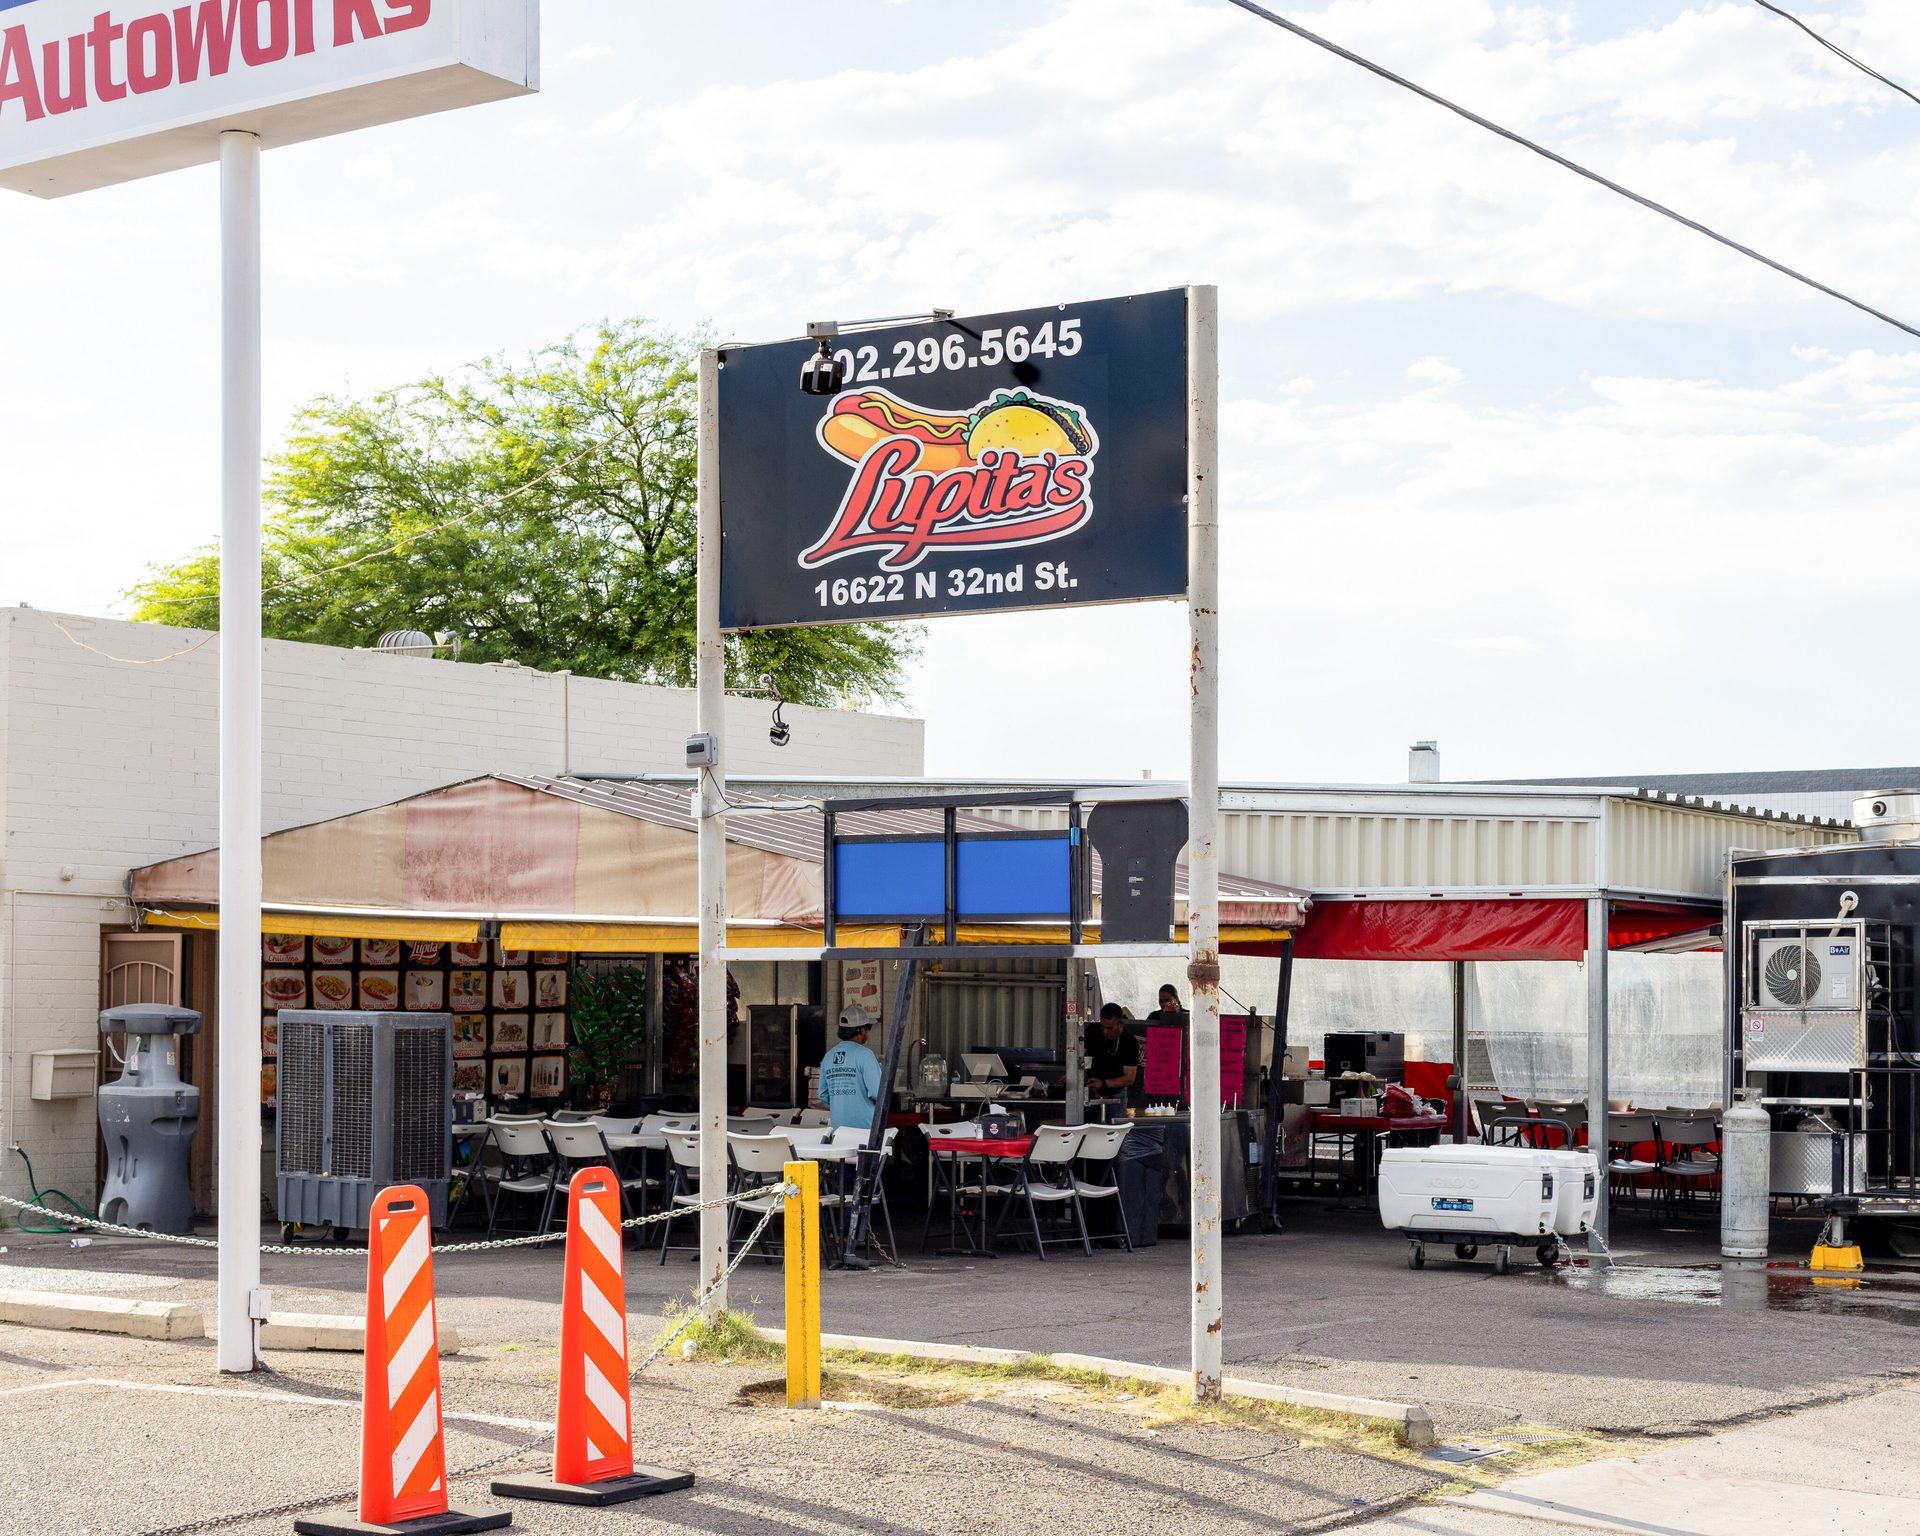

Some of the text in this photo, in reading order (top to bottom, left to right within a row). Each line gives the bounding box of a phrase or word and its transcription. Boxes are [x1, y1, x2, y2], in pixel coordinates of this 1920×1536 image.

[806, 319, 1083, 384] 02.296.5645
[801, 437, 1089, 568] Lupita's
[814, 561, 1078, 607] 16622 N 32nd St.
